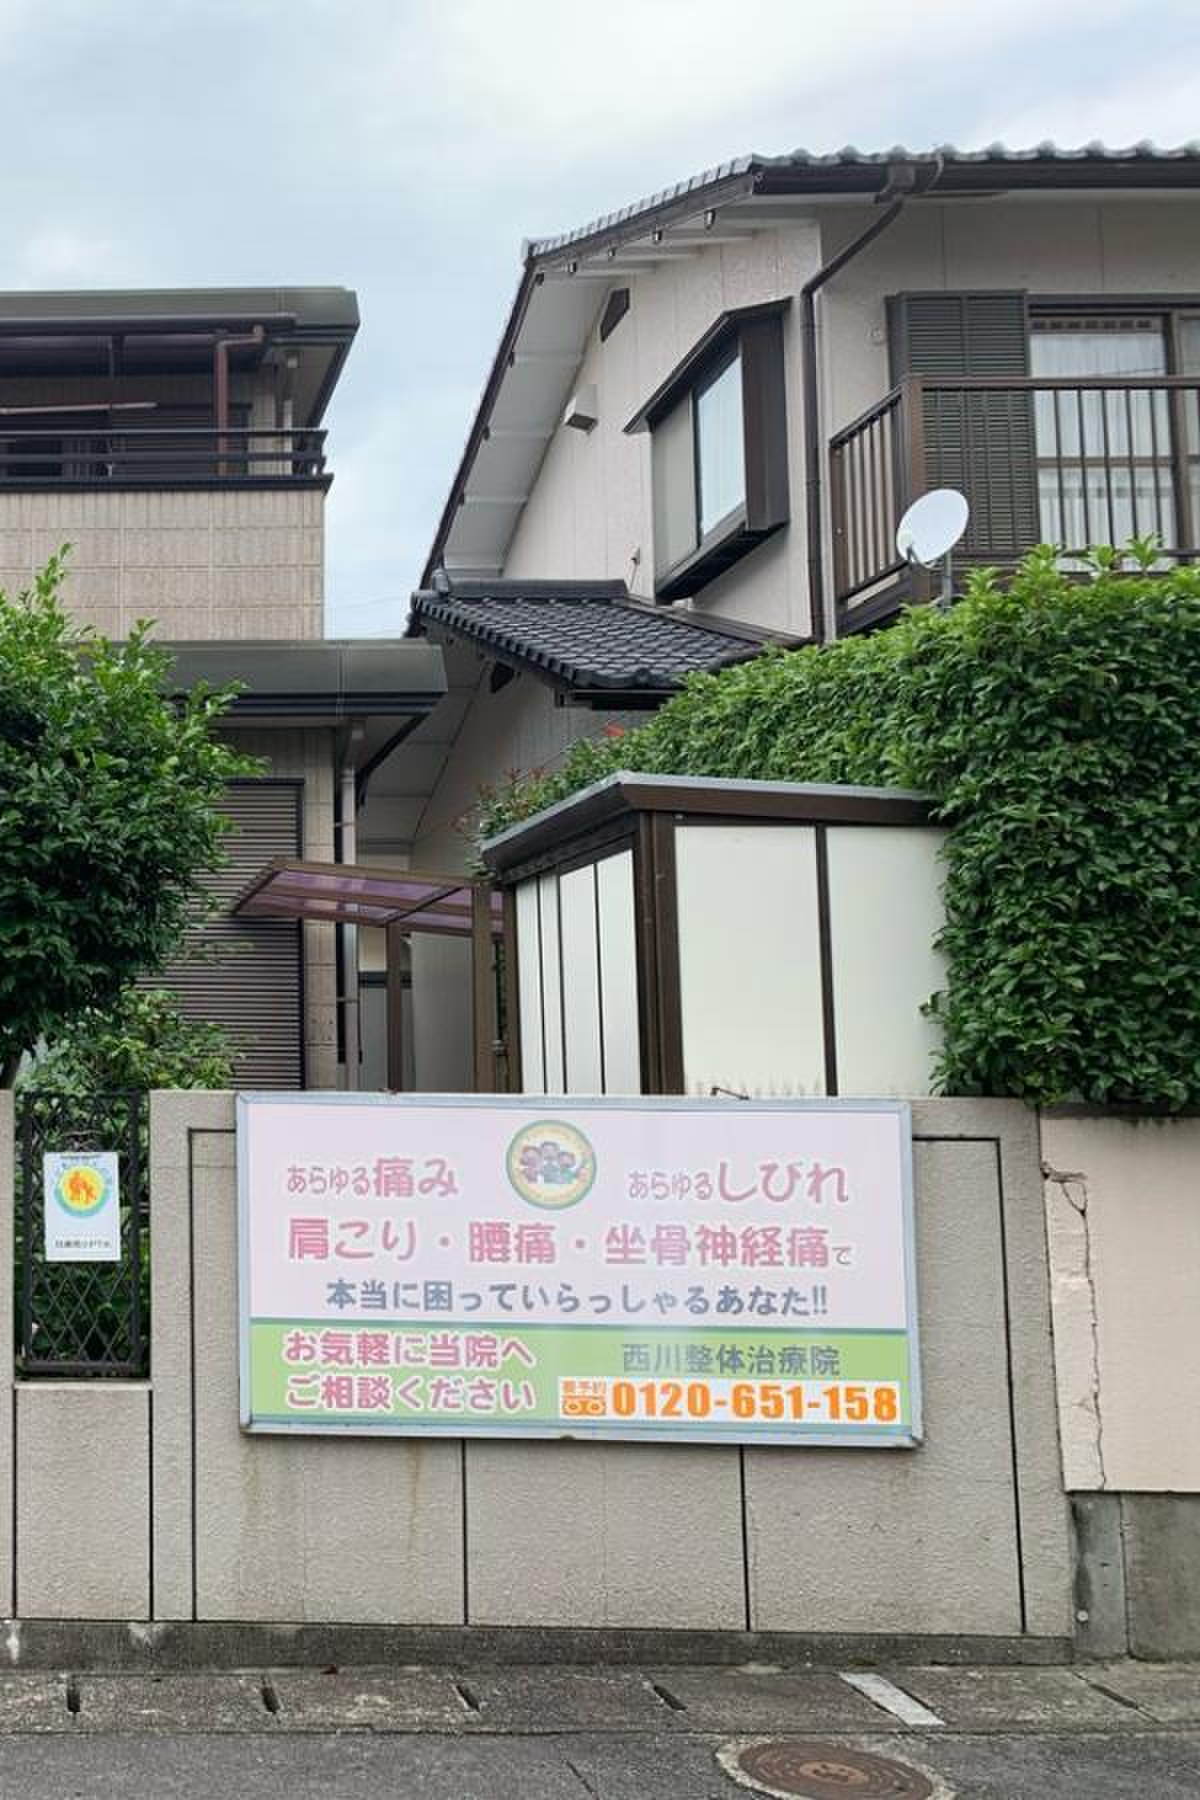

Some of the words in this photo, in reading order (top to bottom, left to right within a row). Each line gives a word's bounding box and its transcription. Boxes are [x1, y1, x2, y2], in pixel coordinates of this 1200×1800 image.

[286, 1157, 457, 1198] あらゆる痛み
[628, 1161, 848, 1203] あらゆるしびれ
[286, 1331, 533, 1366] お気軽に当院へ
[623, 1344, 840, 1376] 西川整体治療院
[287, 1376, 534, 1411] ご相談ください
[613, 1382, 897, 1421] 0120-651-158
